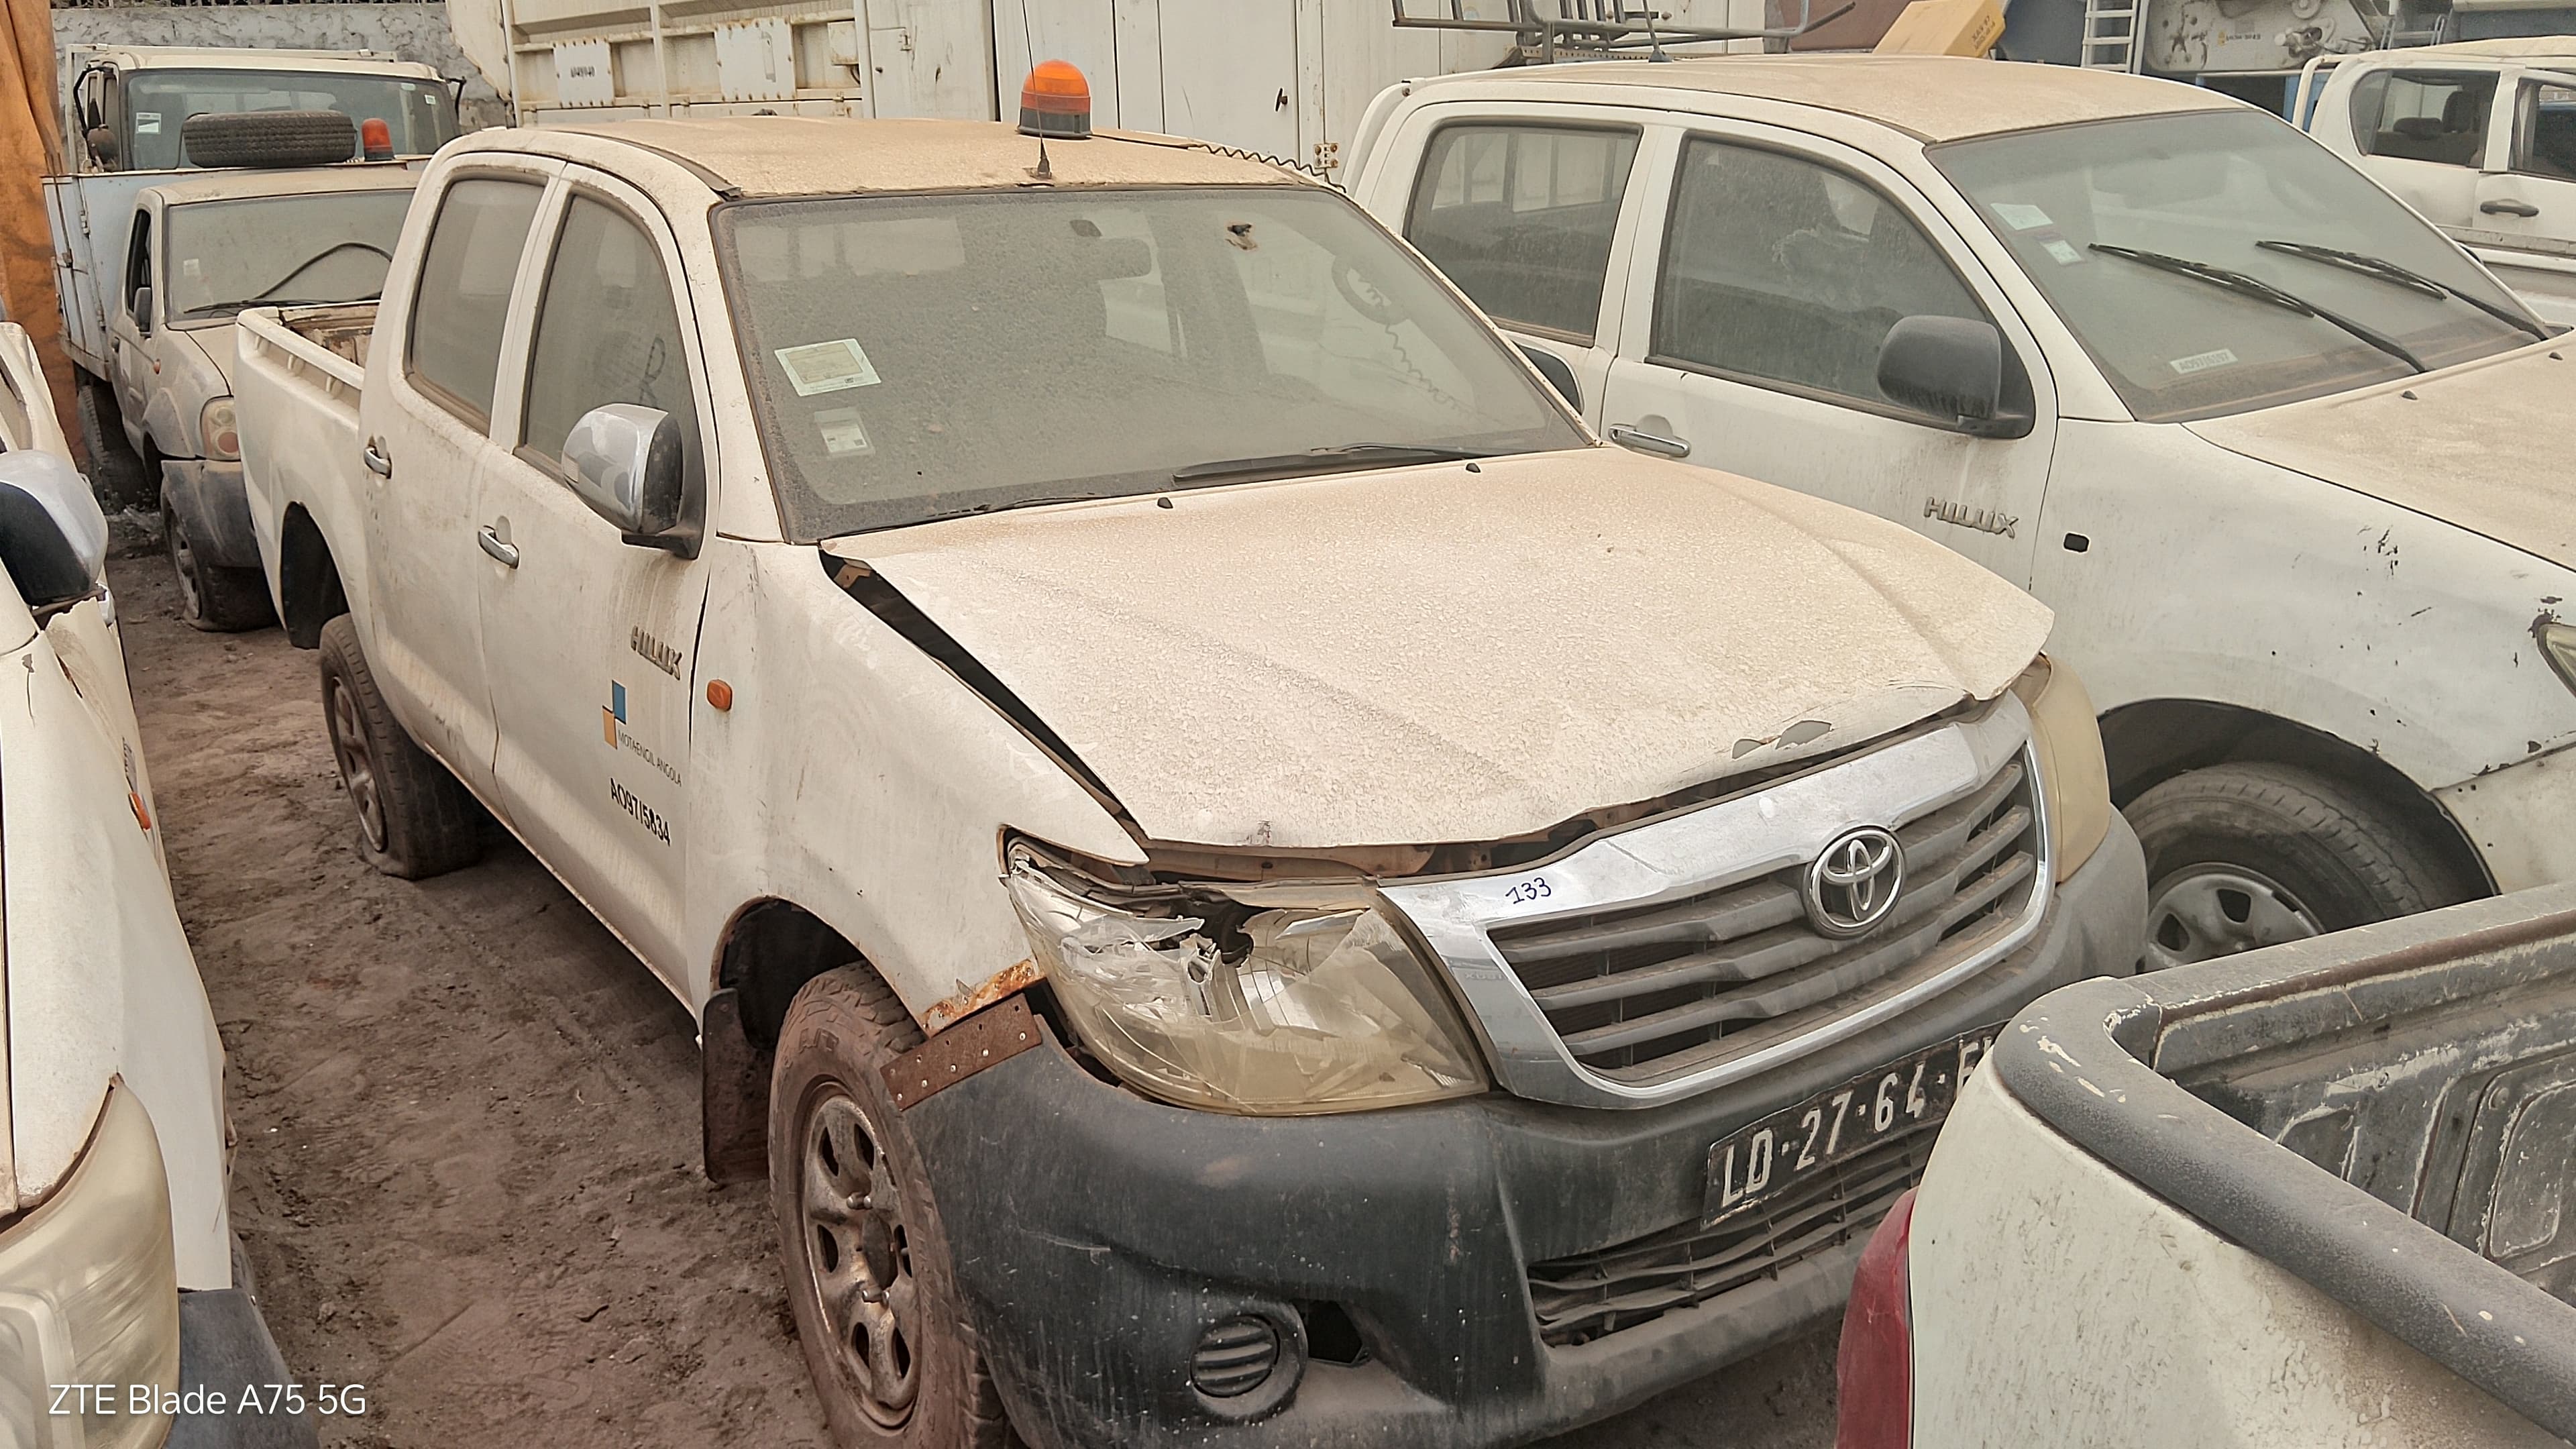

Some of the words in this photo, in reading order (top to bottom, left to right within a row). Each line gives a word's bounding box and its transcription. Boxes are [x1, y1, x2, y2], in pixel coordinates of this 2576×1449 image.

[1923, 496, 2019, 539] HILUX
[630, 625, 684, 680] HILUX
[1505, 876, 1552, 905] 133
